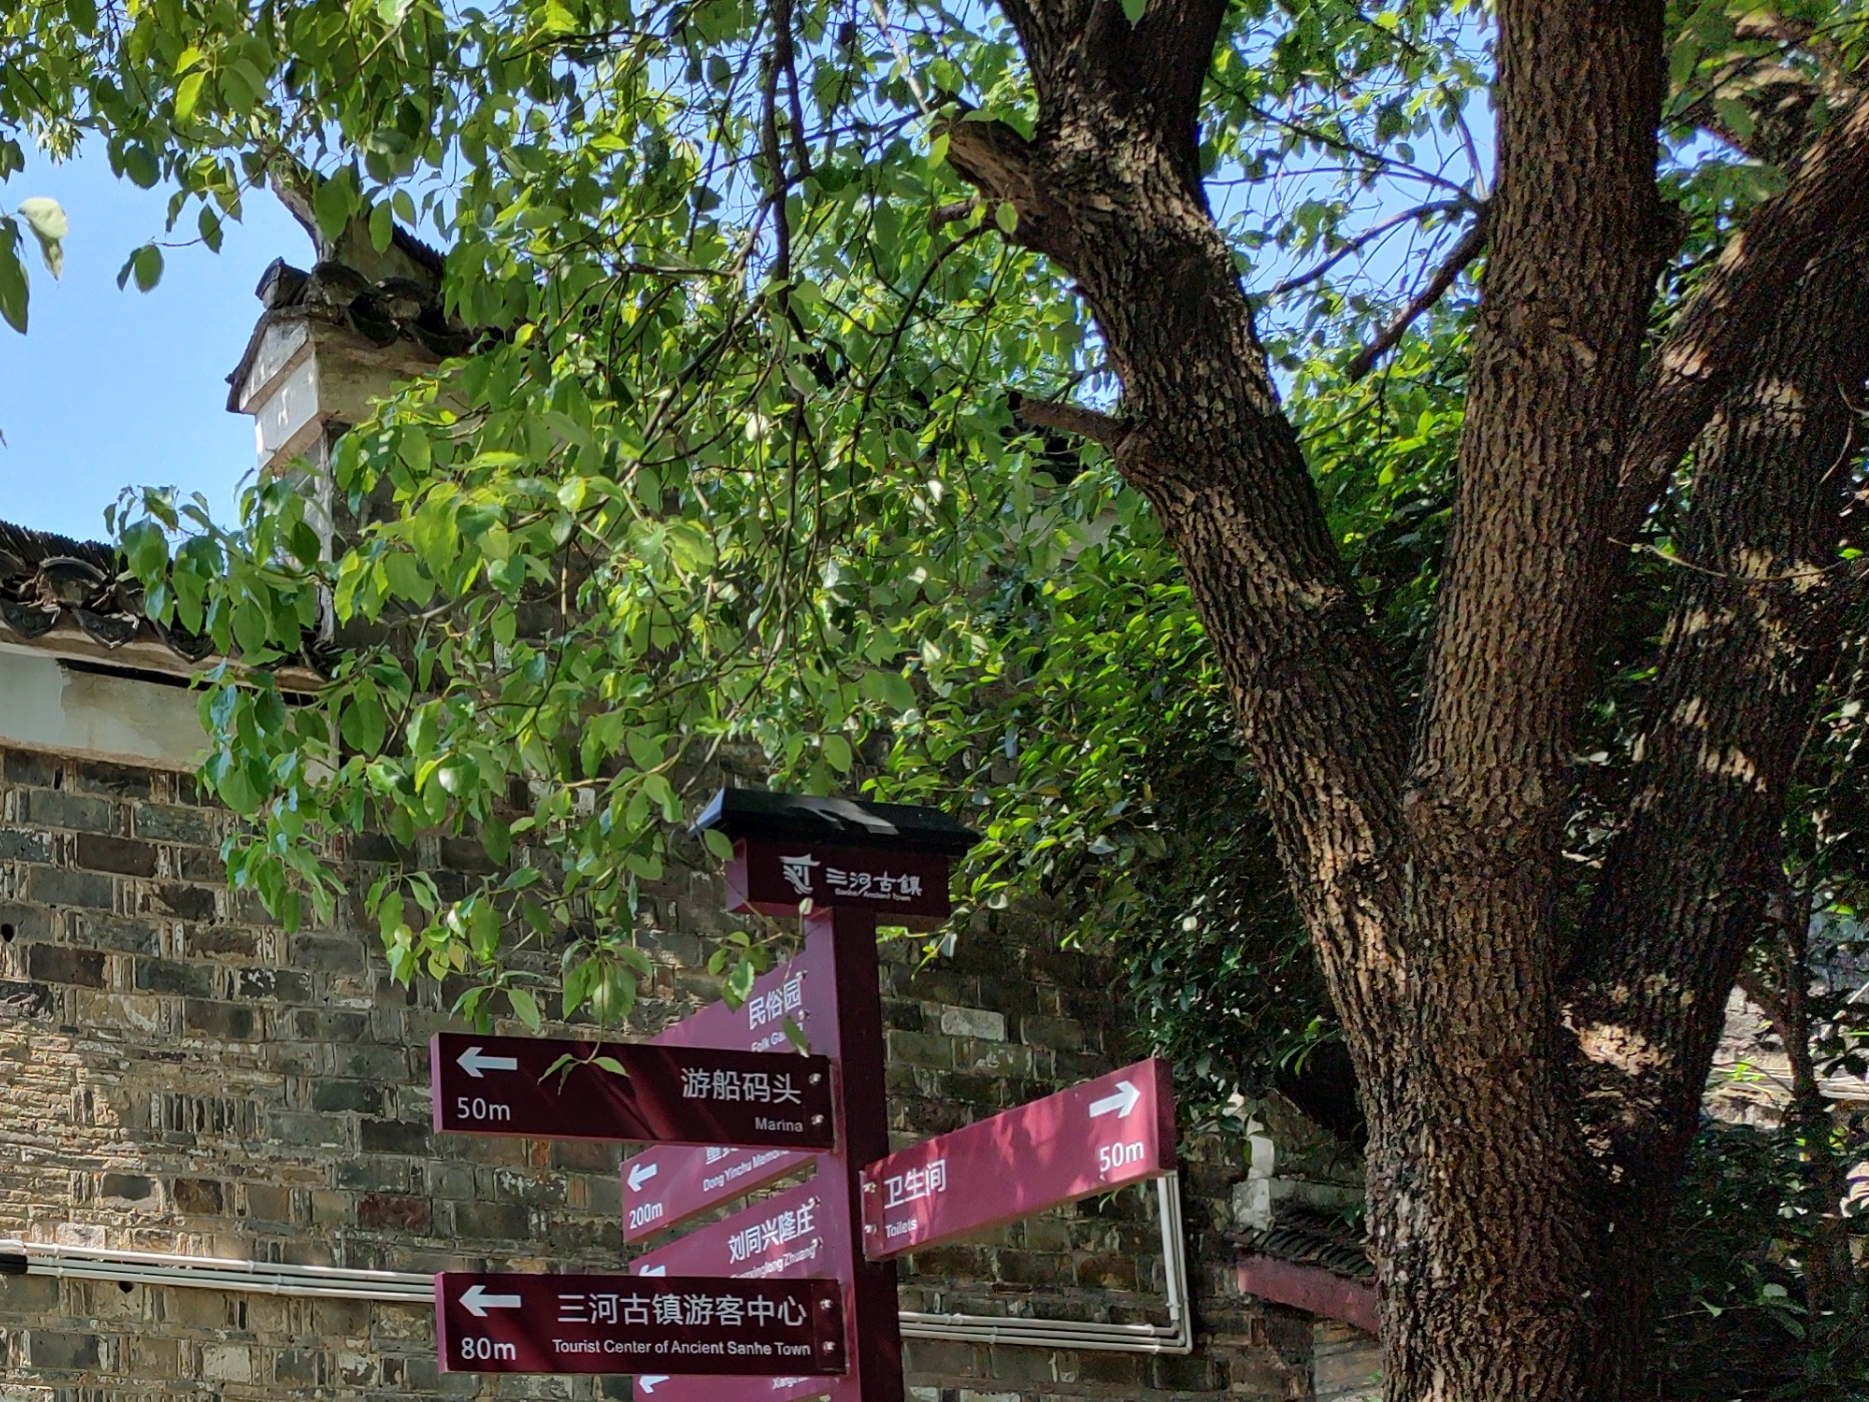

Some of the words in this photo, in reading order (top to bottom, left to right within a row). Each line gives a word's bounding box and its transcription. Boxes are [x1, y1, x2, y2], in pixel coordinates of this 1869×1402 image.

[749, 978, 802, 1030] 民俗园
[681, 1067, 803, 1105] 游船码头
[457, 1097, 511, 1121] 50m
[755, 1117, 803, 1132] Marina
[1098, 1141, 1144, 1173] 50m
[884, 1159, 946, 1209] 卫生间
[629, 1203, 664, 1229] 200m
[885, 1218, 917, 1238] Toilets
[728, 1203, 815, 1264] 刘同兴隆庄
[557, 1292, 807, 1327] 三河古镇游客中心
[461, 1337, 516, 1360] 80m
[553, 1339, 600, 1354] Tourist
[604, 1340, 651, 1355] Center
[655, 1340, 669, 1355] of
[672, 1340, 724, 1355] Ancient
[727, 1341, 772, 1356] Sanhe
[776, 1342, 811, 1357] Town
